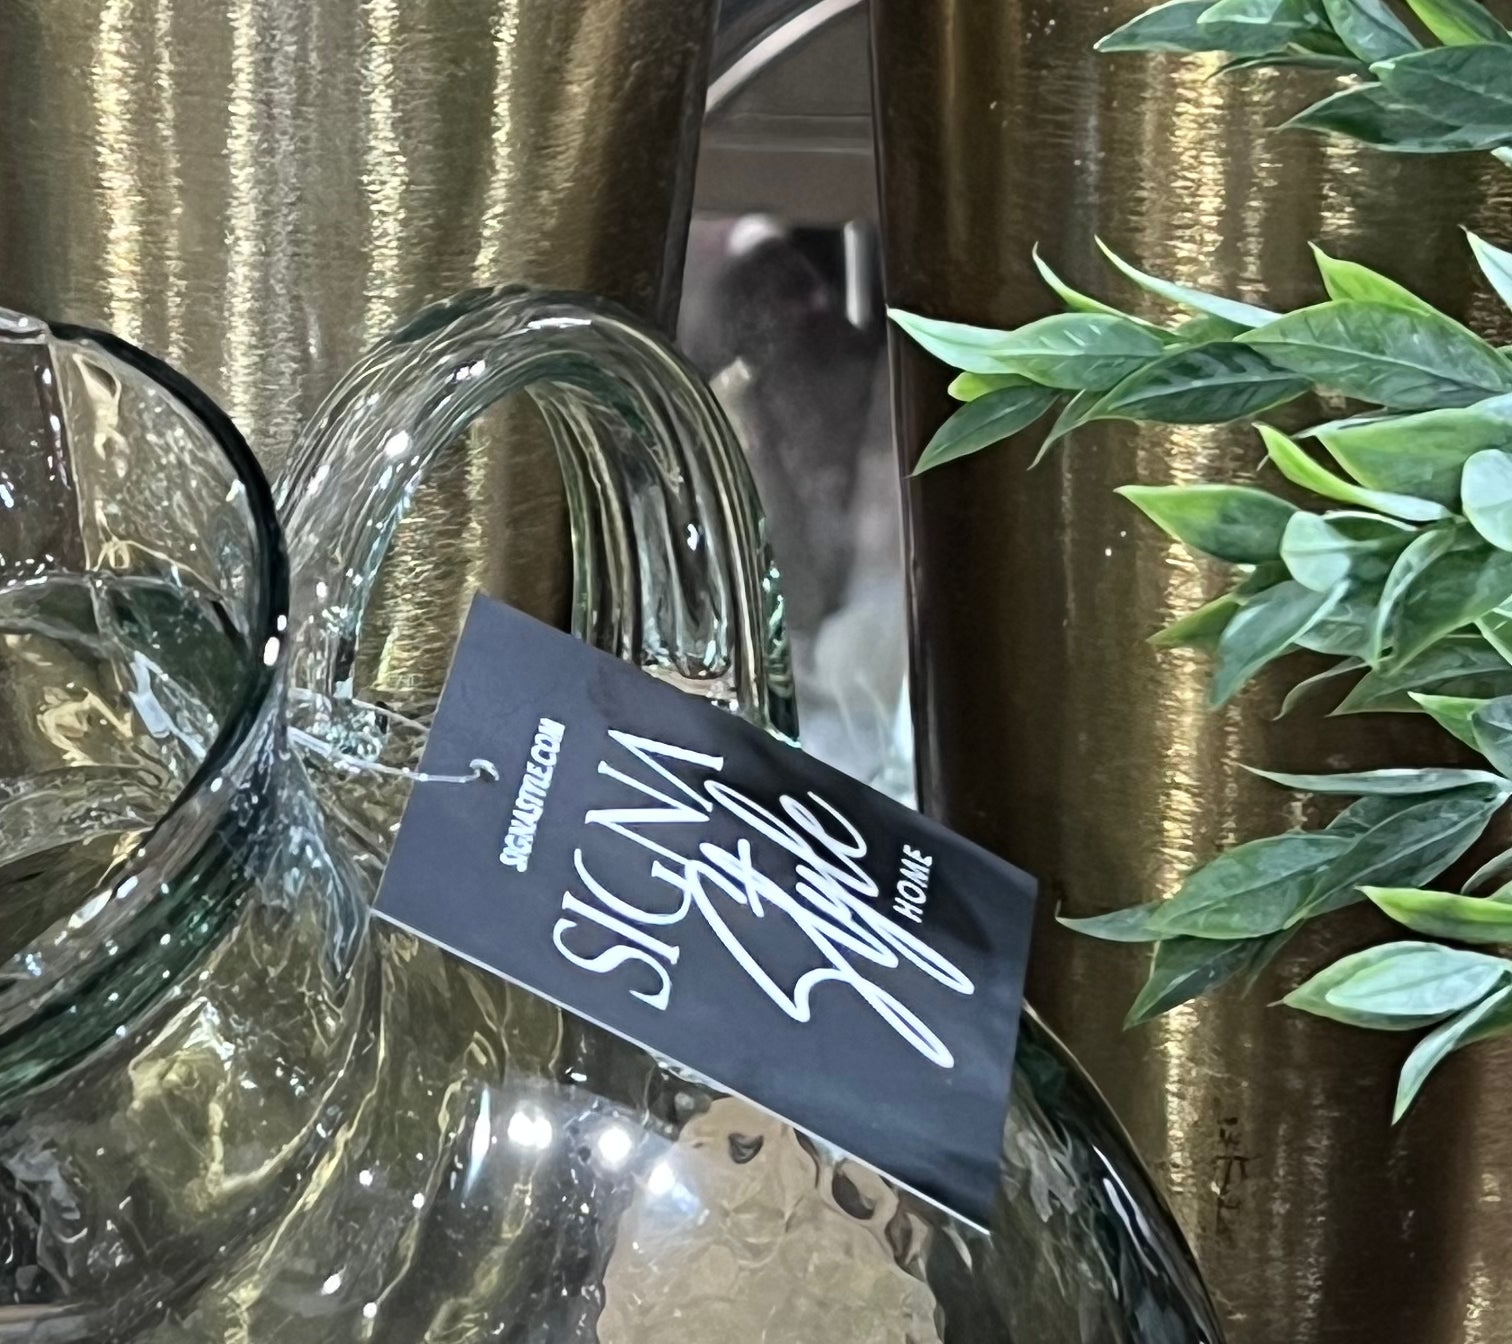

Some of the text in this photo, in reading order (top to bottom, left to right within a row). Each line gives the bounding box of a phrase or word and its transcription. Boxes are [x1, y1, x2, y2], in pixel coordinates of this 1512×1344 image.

[552, 728, 724, 1011] SIGNA
[686, 779, 975, 1069] Style
[892, 844, 934, 923] HOME
